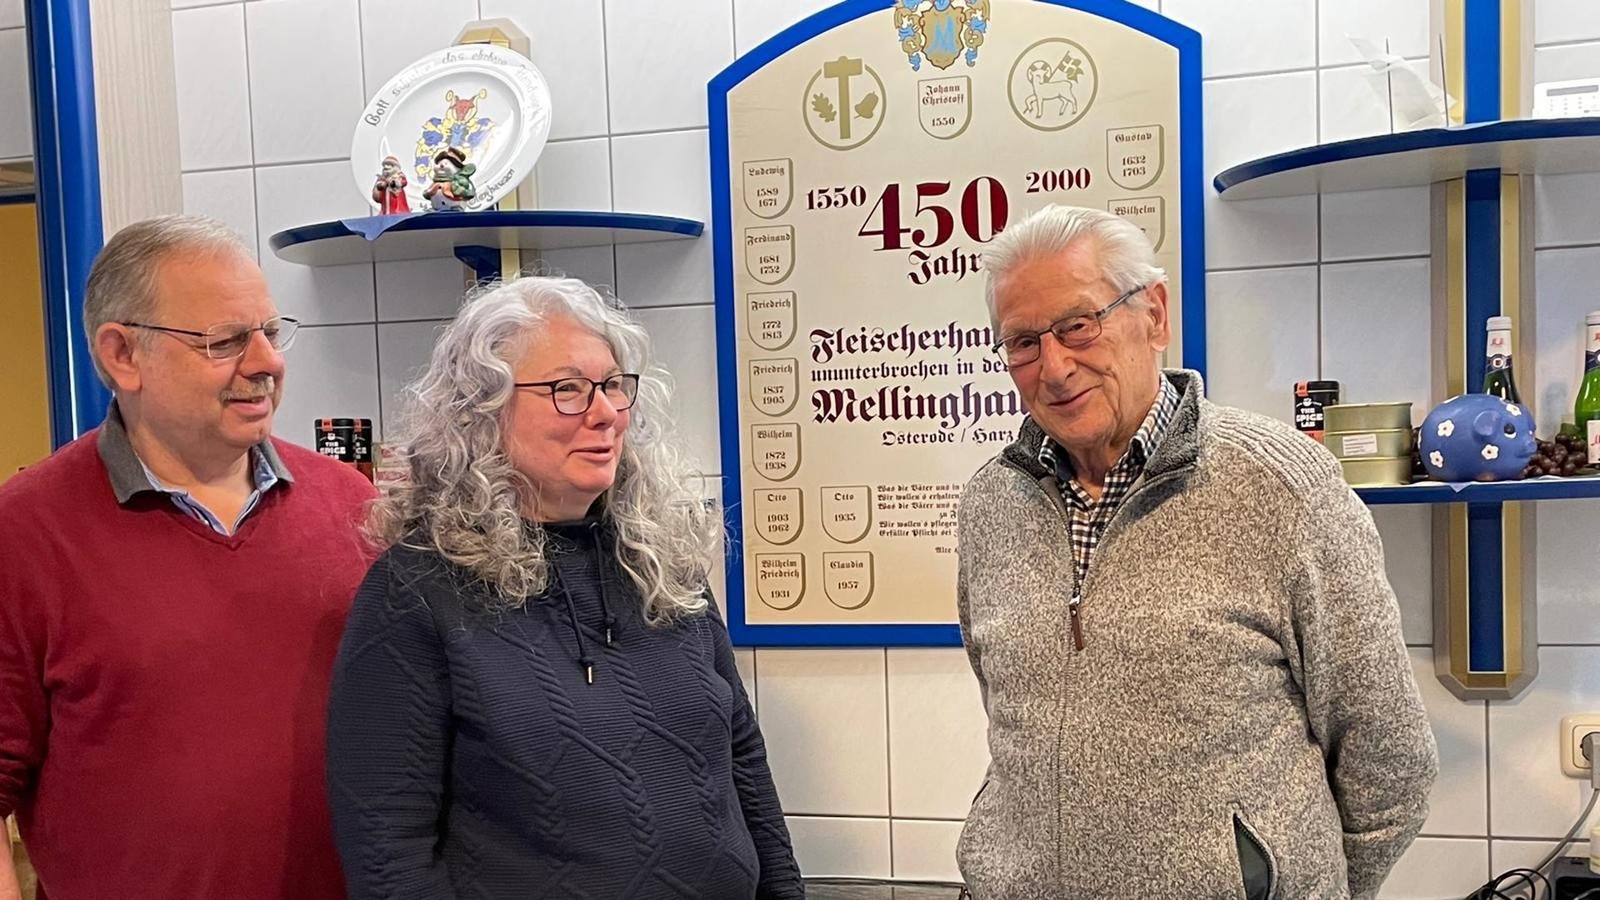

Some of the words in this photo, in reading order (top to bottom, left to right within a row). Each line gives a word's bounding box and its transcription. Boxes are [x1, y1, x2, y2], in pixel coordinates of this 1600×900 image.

[925, 84, 960, 97] Johann
[931, 117, 955, 127] 1550
[1121, 155, 1147, 167] 1632
[1122, 166, 1147, 178] 1703
[1024, 166, 1092, 194] 2000
[757, 187, 779, 197] 1589
[805, 184, 867, 211] 1550
[759, 198, 777, 208] 1671
[857, 175, 1010, 252] 450
[1114, 204, 1157, 217] Wilhelm
[746, 232, 791, 246] Ferdinand
[759, 255, 780, 265] 1681
[760, 265, 780, 275] 1752
[751, 298, 791, 311] Friedrich
[762, 320, 782, 330] 1772
[762, 330, 783, 340] 1813
[752, 364, 793, 377] Friedrich
[811, 359, 949, 383] ununterbrochen
[957, 357, 974, 375] in
[763, 385, 785, 395] 1837
[763, 396, 786, 405] 1905
[757, 430, 793, 440] Wilhelm
[882, 429, 955, 446] Osterode
[971, 427, 1015, 447] Harz
[765, 451, 787, 460] 1872
[765, 462, 787, 470] 1938
[767, 493, 788, 503] Otto
[834, 492, 855, 502] Otto
[767, 513, 790, 523] 1903
[834, 513, 857, 523] 1935
[767, 524, 790, 533] 1962
[761, 558, 798, 568] Wilhelm
[829, 559, 864, 570] Claudia
[760, 569, 800, 580] Friedrich
[837, 581, 860, 590] 1957
[770, 589, 790, 599] 1931
